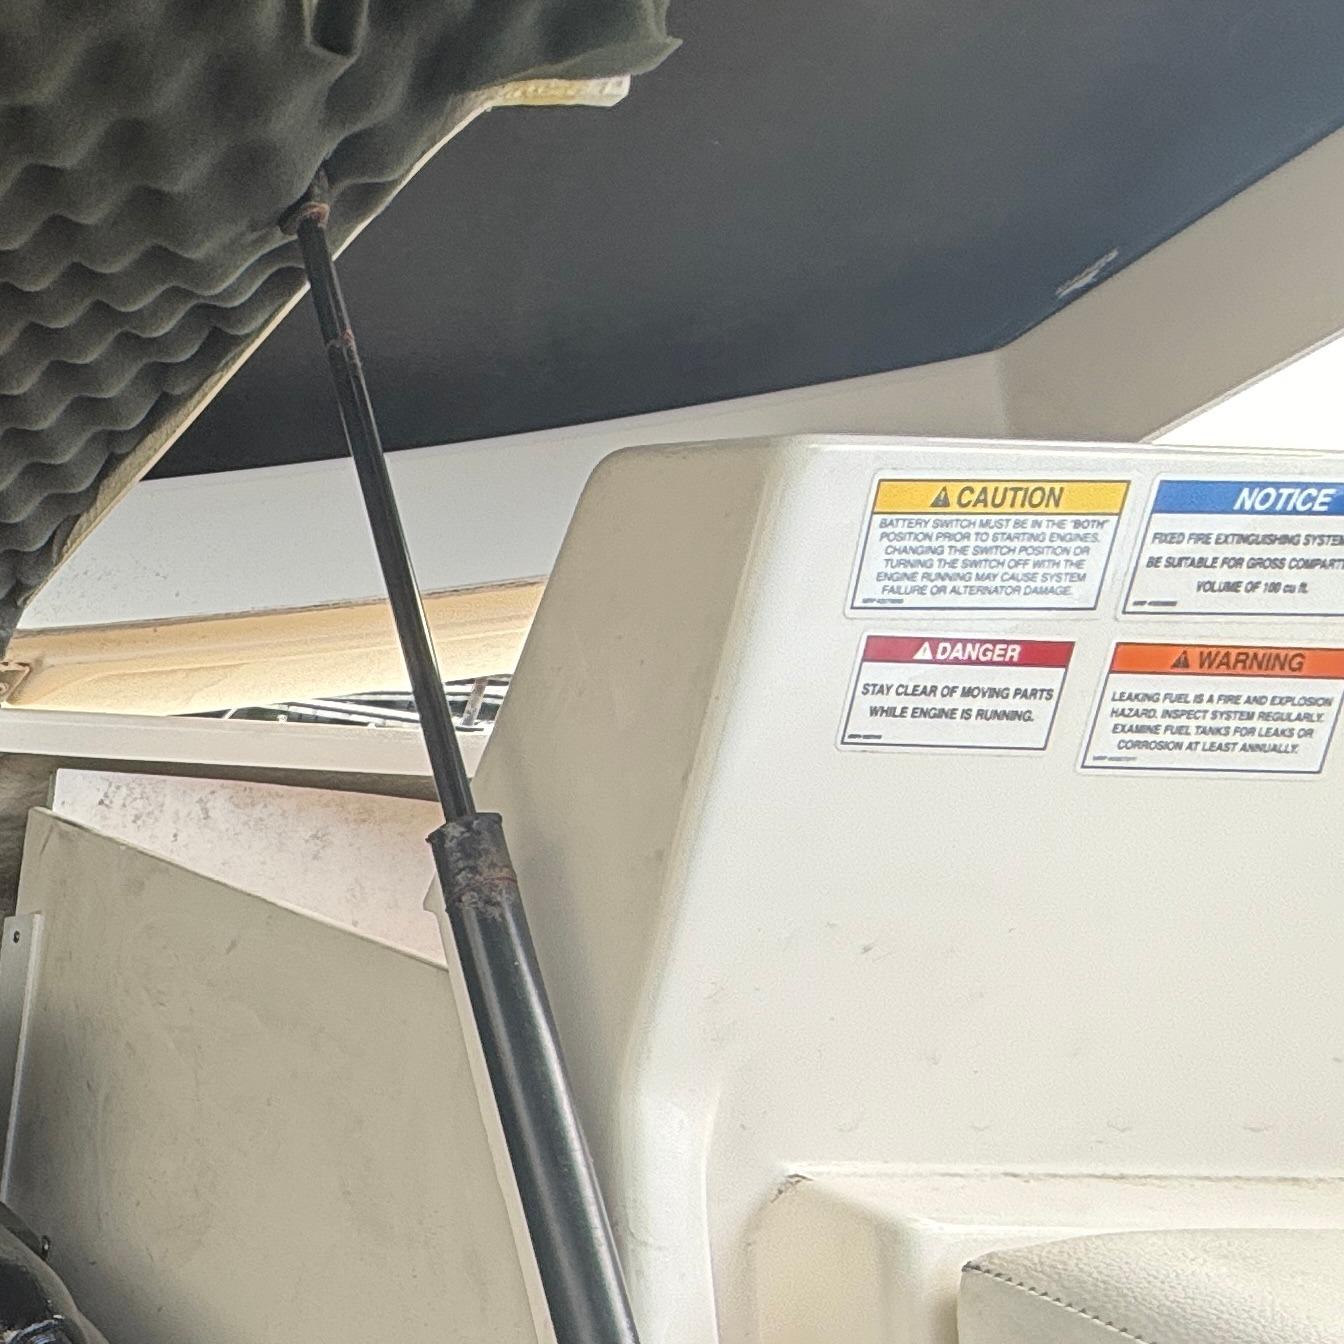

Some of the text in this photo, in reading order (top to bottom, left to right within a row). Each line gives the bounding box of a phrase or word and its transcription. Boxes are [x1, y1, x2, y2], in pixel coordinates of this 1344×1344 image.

[957, 486, 1064, 508] CAUTION
[1233, 488, 1336, 511] NOTICE
[879, 519, 928, 529] BATTERY
[932, 519, 976, 529] SWITCH
[979, 519, 1009, 529] MUST
[1012, 519, 1028, 529] BE
[1031, 519, 1041, 529] IN
[1045, 519, 1066, 529] THE
[879, 532, 933, 542] POSITION
[936, 532, 970, 542] PRIOR
[974, 532, 988, 542] TO
[992, 532, 1045, 542] STARTING
[1152, 533, 1185, 544] FIXED
[1187, 533, 1212, 545] FIRE
[1215, 533, 1301, 546] EXTINGUISHING
[885, 545, 1089, 555] CHANGING THE SWITCH POSITION OR
[884, 559, 1085, 569] TURNING THE SWITCH OFF WITH THE
[1146, 557, 1161, 568] BE
[1164, 557, 1218, 568] SUITABLE
[1221, 557, 1243, 569] FOR
[1246, 558, 1285, 569] GROSS
[876, 572, 1086, 582] ENGINE RUNNING MAY CAUSE SYSTEM
[881, 585, 926, 595] FAILURE
[930, 585, 946, 595] OR
[949, 585, 1021, 595] ALTERNATOR
[1196, 581, 1242, 592] VOLUME
[1245, 581, 1261, 593] OF
[936, 642, 1021, 662] DANGER
[1199, 652, 1305, 672] WARNING
[862, 684, 1053, 700] STAY CLEAR OF MOVING PARTS
[1111, 692, 1333, 706] LEAKING FUEL IS A FIRE AND EXPLOSION
[869, 706, 1034, 721] WHILE ENGINE IS RUNNING.
[1161, 709, 1207, 720] INSPECT
[1211, 710, 1255, 721] SYSTEM
[1257, 711, 1325, 722] REGULARLY.
[1112, 724, 1313, 738] EXAMINE FUEL TANKS FOR LEAKS OR
[1117, 740, 1298, 753] CORROSION AT LEAST ANNUALLY.
